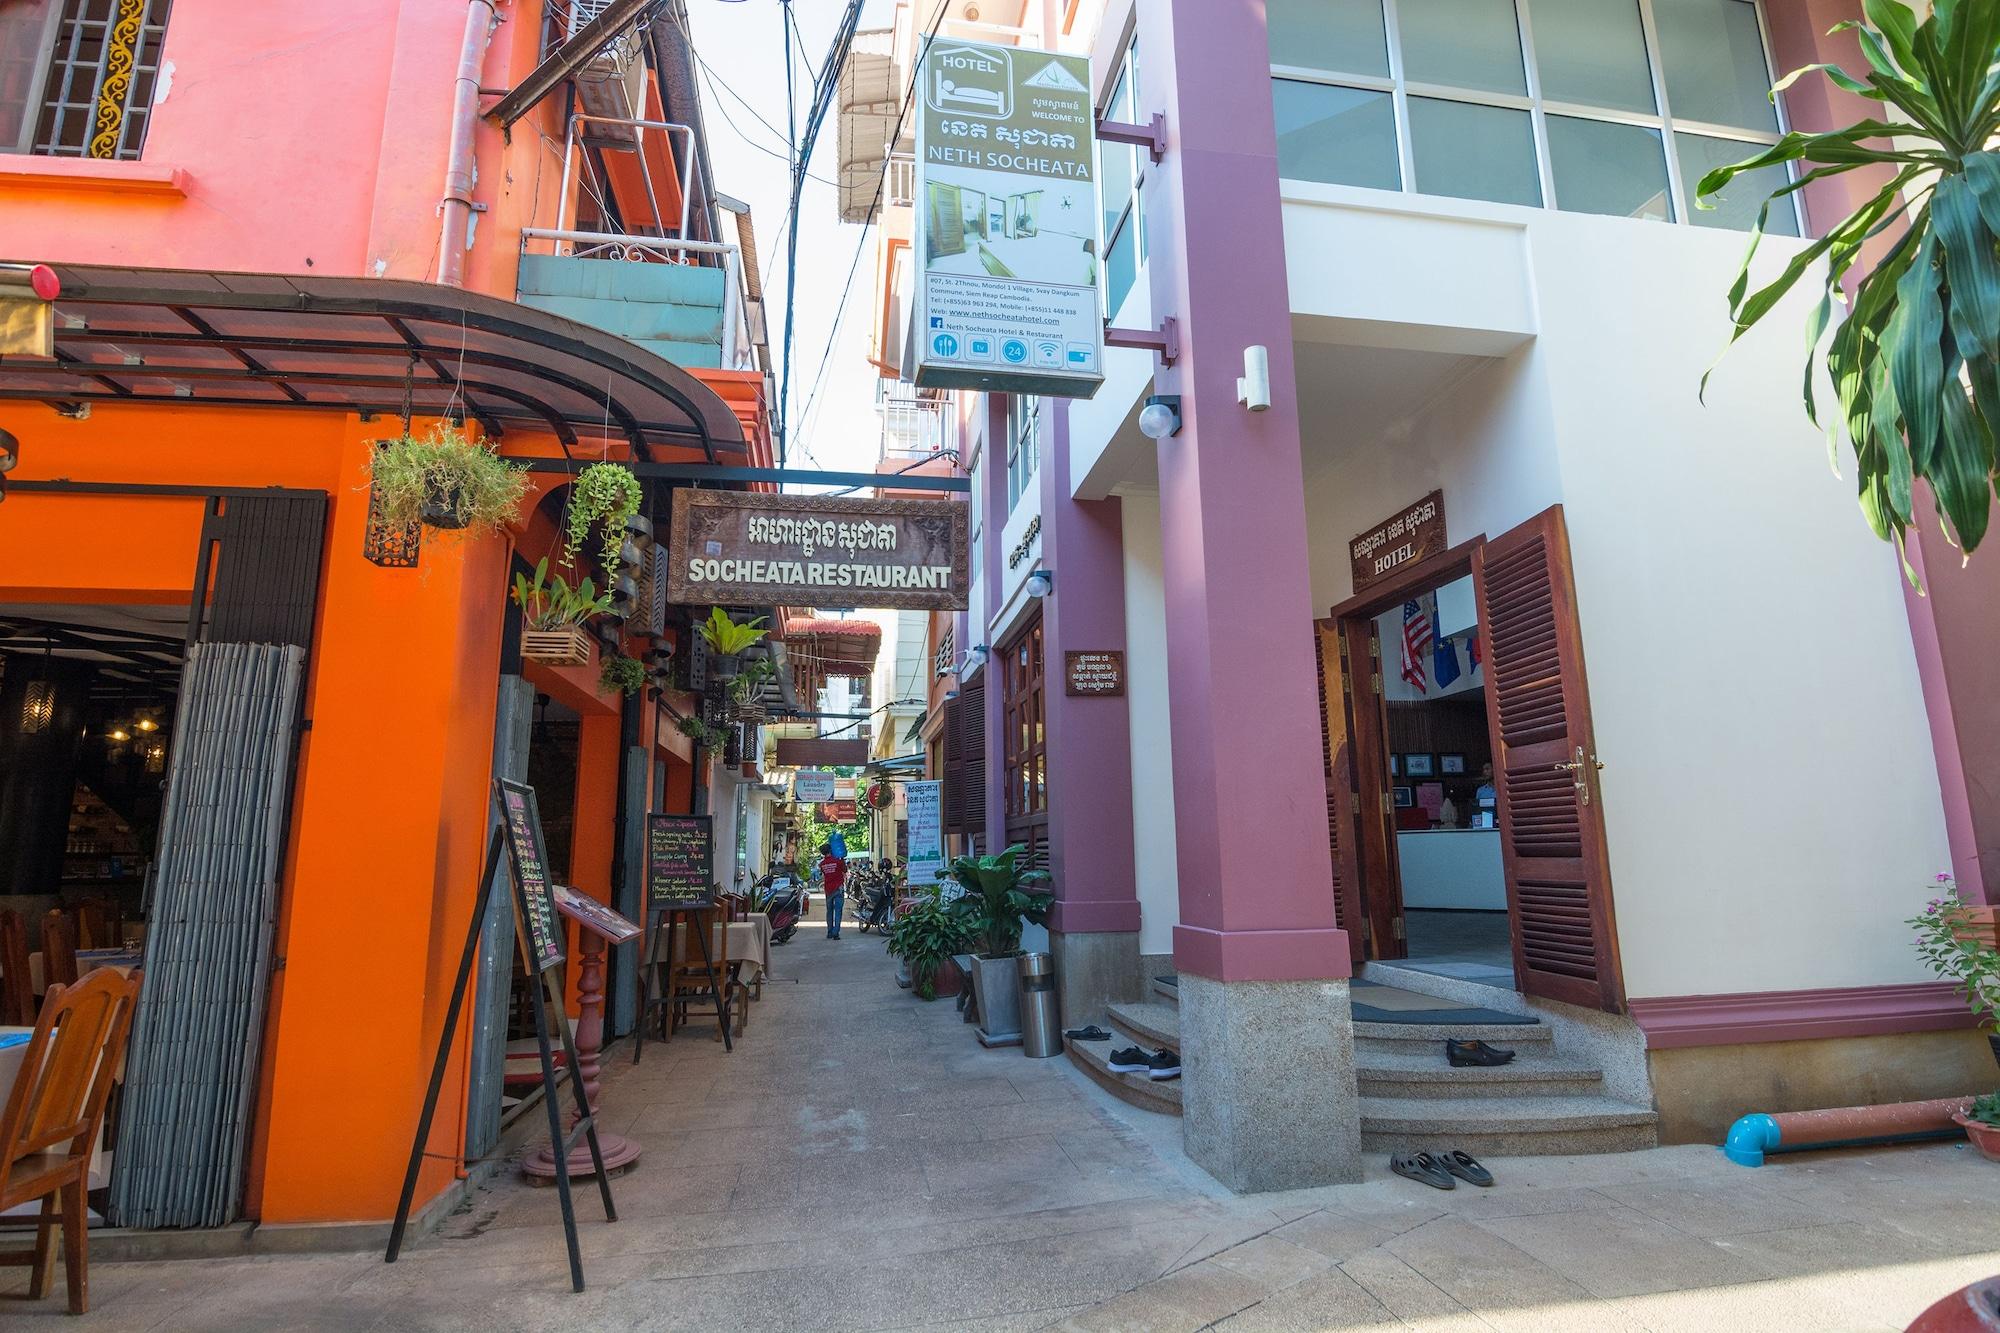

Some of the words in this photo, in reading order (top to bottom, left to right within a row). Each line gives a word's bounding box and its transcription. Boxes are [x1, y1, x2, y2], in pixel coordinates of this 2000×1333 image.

[943, 55, 997, 73] HOTEL
[1032, 111, 1072, 122] WELCOME
[1073, 116, 1085, 124] TO
[929, 145, 981, 164] NETH
[987, 152, 1089, 178] SOCHEATA
[931, 288, 964, 296] Commune,
[1013, 285, 1035, 293] Village,
[1051, 289, 1080, 297] Dangkum
[949, 310, 1060, 325] www.nethsocheatahotel.com
[965, 325, 997, 333] Socheata
[1026, 331, 1063, 339] Restaurant
[1008, 347, 1022, 357] 24
[838, 519, 897, 560] សុជាតា
[1374, 542, 1416, 575] HOTEL
[688, 558, 805, 585] SOCHEATA
[805, 562, 952, 589] RESTAURANT
